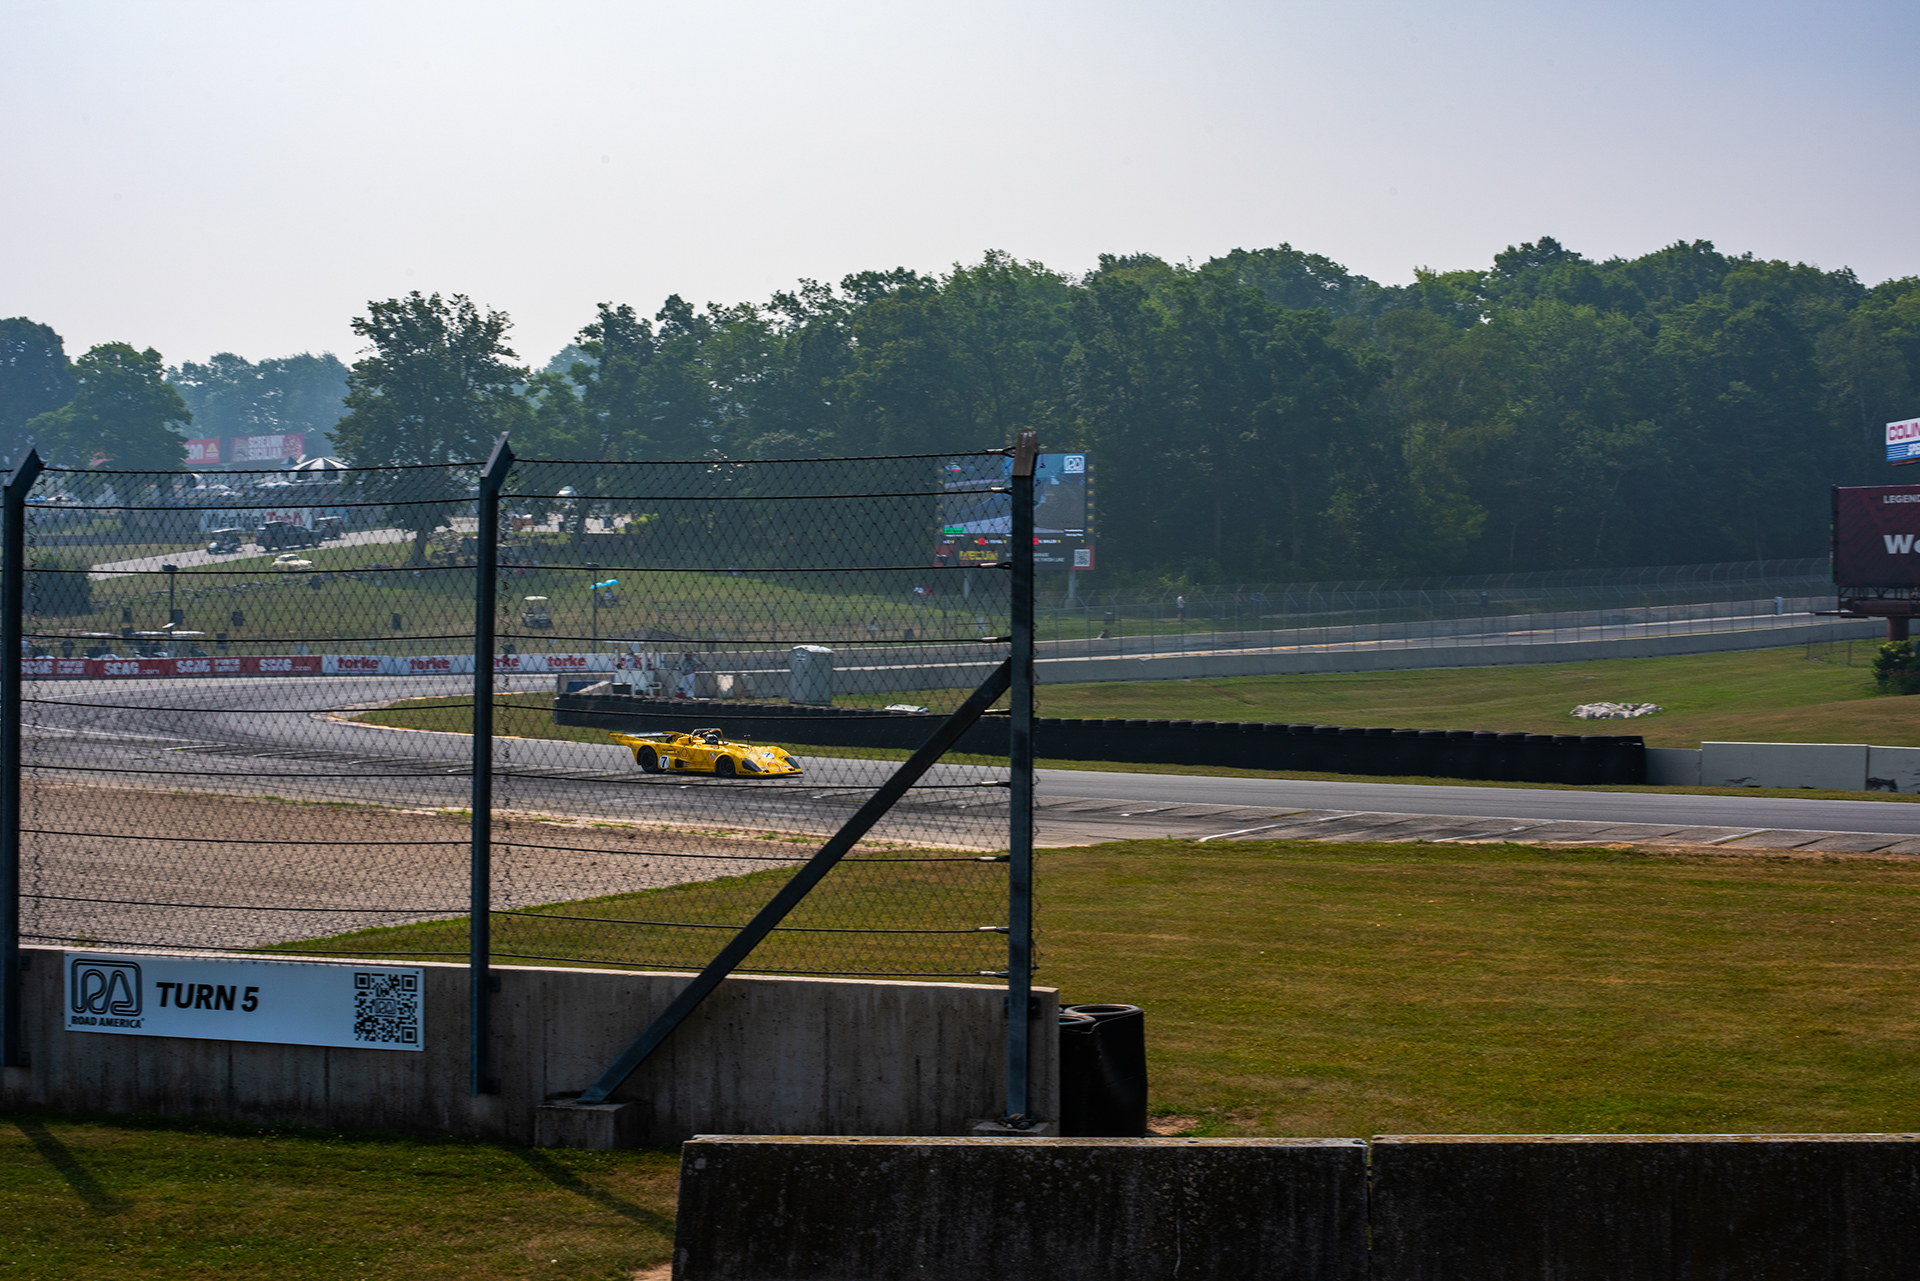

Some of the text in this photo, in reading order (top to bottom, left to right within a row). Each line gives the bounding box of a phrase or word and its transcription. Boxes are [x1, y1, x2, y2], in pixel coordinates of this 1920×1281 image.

[176, 659, 211, 674] SCAG
[337, 656, 379, 669] torke
[409, 657, 451, 670] torke
[547, 655, 586, 667] torke
[661, 756, 668, 768] 7
[156, 981, 260, 1012] TURN 5
[71, 1015, 97, 1026] ROAD
